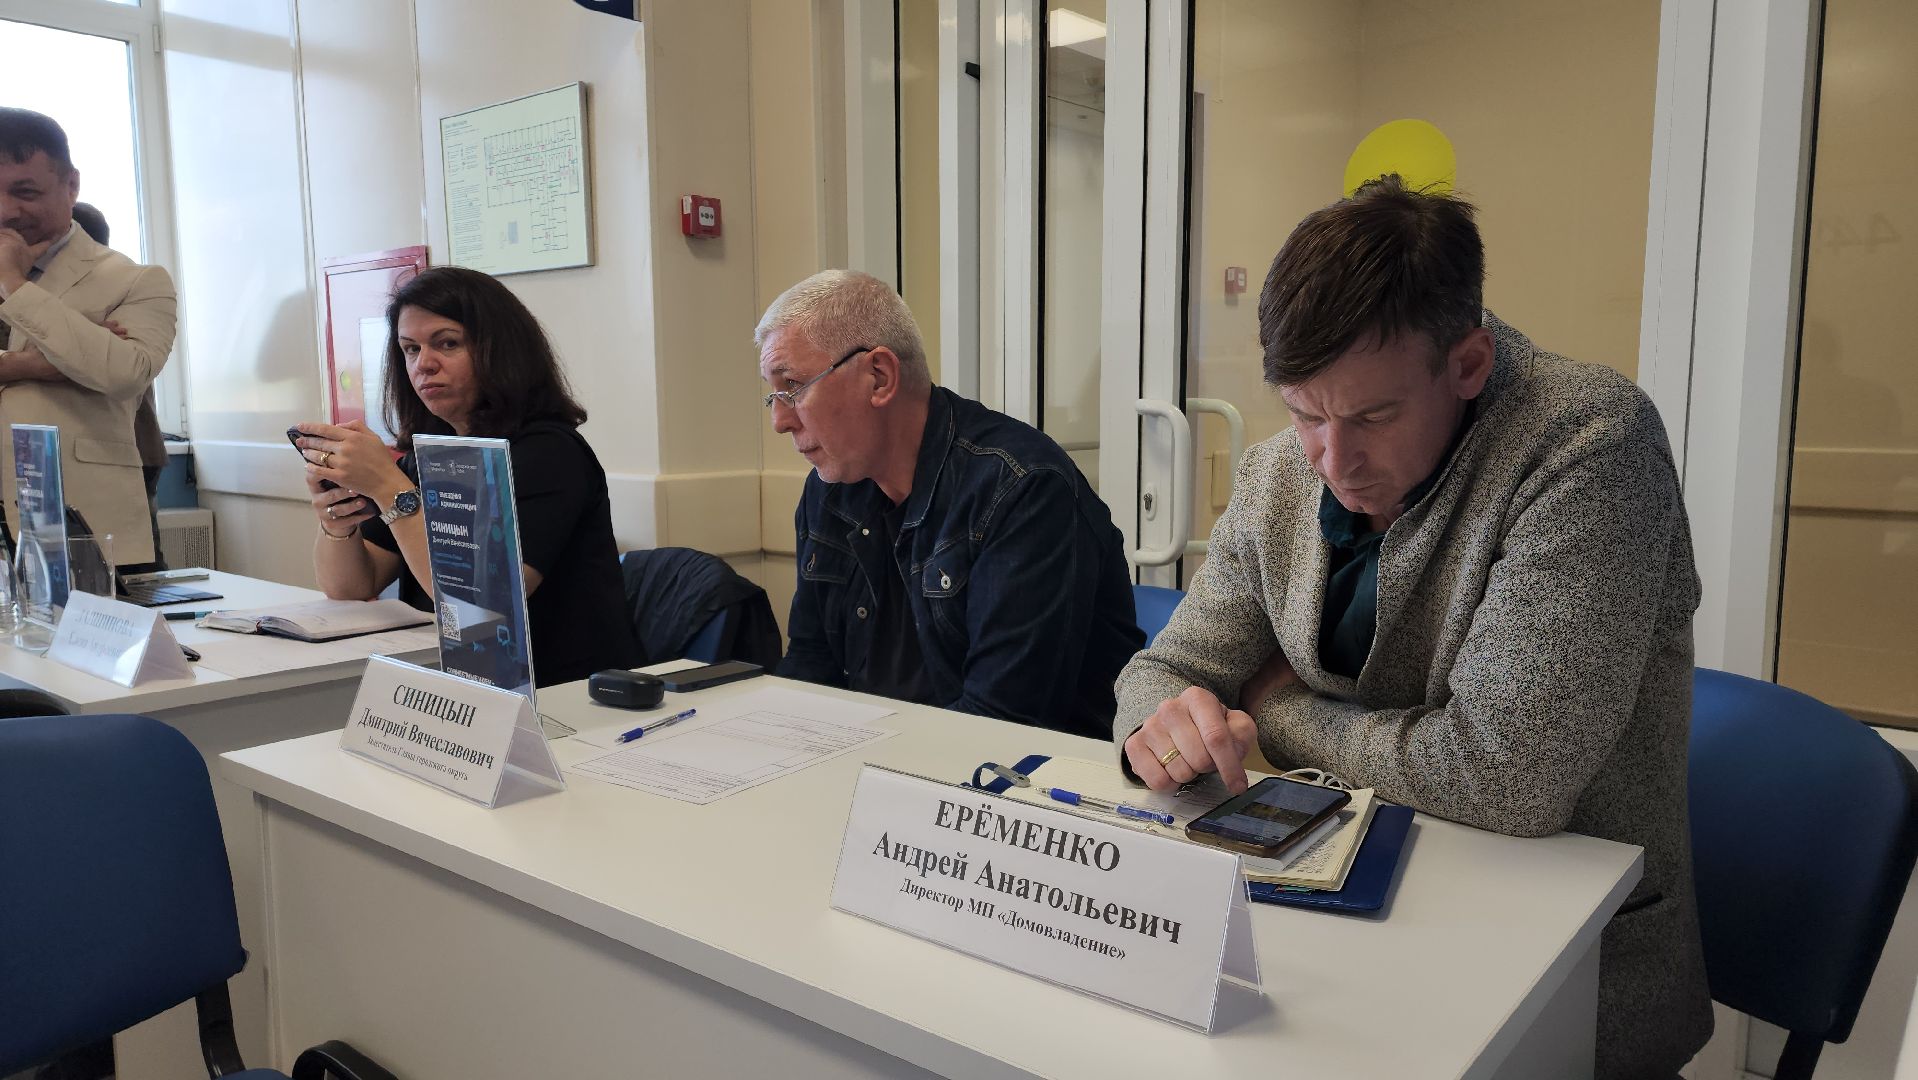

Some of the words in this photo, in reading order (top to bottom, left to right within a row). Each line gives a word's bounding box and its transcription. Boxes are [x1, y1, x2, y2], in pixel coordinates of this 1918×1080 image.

[430, 520, 469, 537] СИНИЦЫН
[357, 707, 408, 739] Дмитрий
[408, 723, 495, 770] Вячеславович
[393, 684, 477, 728] СИНИЦЫН
[933, 799, 1121, 872] ЕРЁМЕНКО
[872, 831, 969, 882] Андрей
[974, 859, 1182, 945] Анатольевич
[899, 878, 964, 913] Директор
[967, 896, 996, 920] МП
[997, 909, 1127, 961] «Домовладение»
